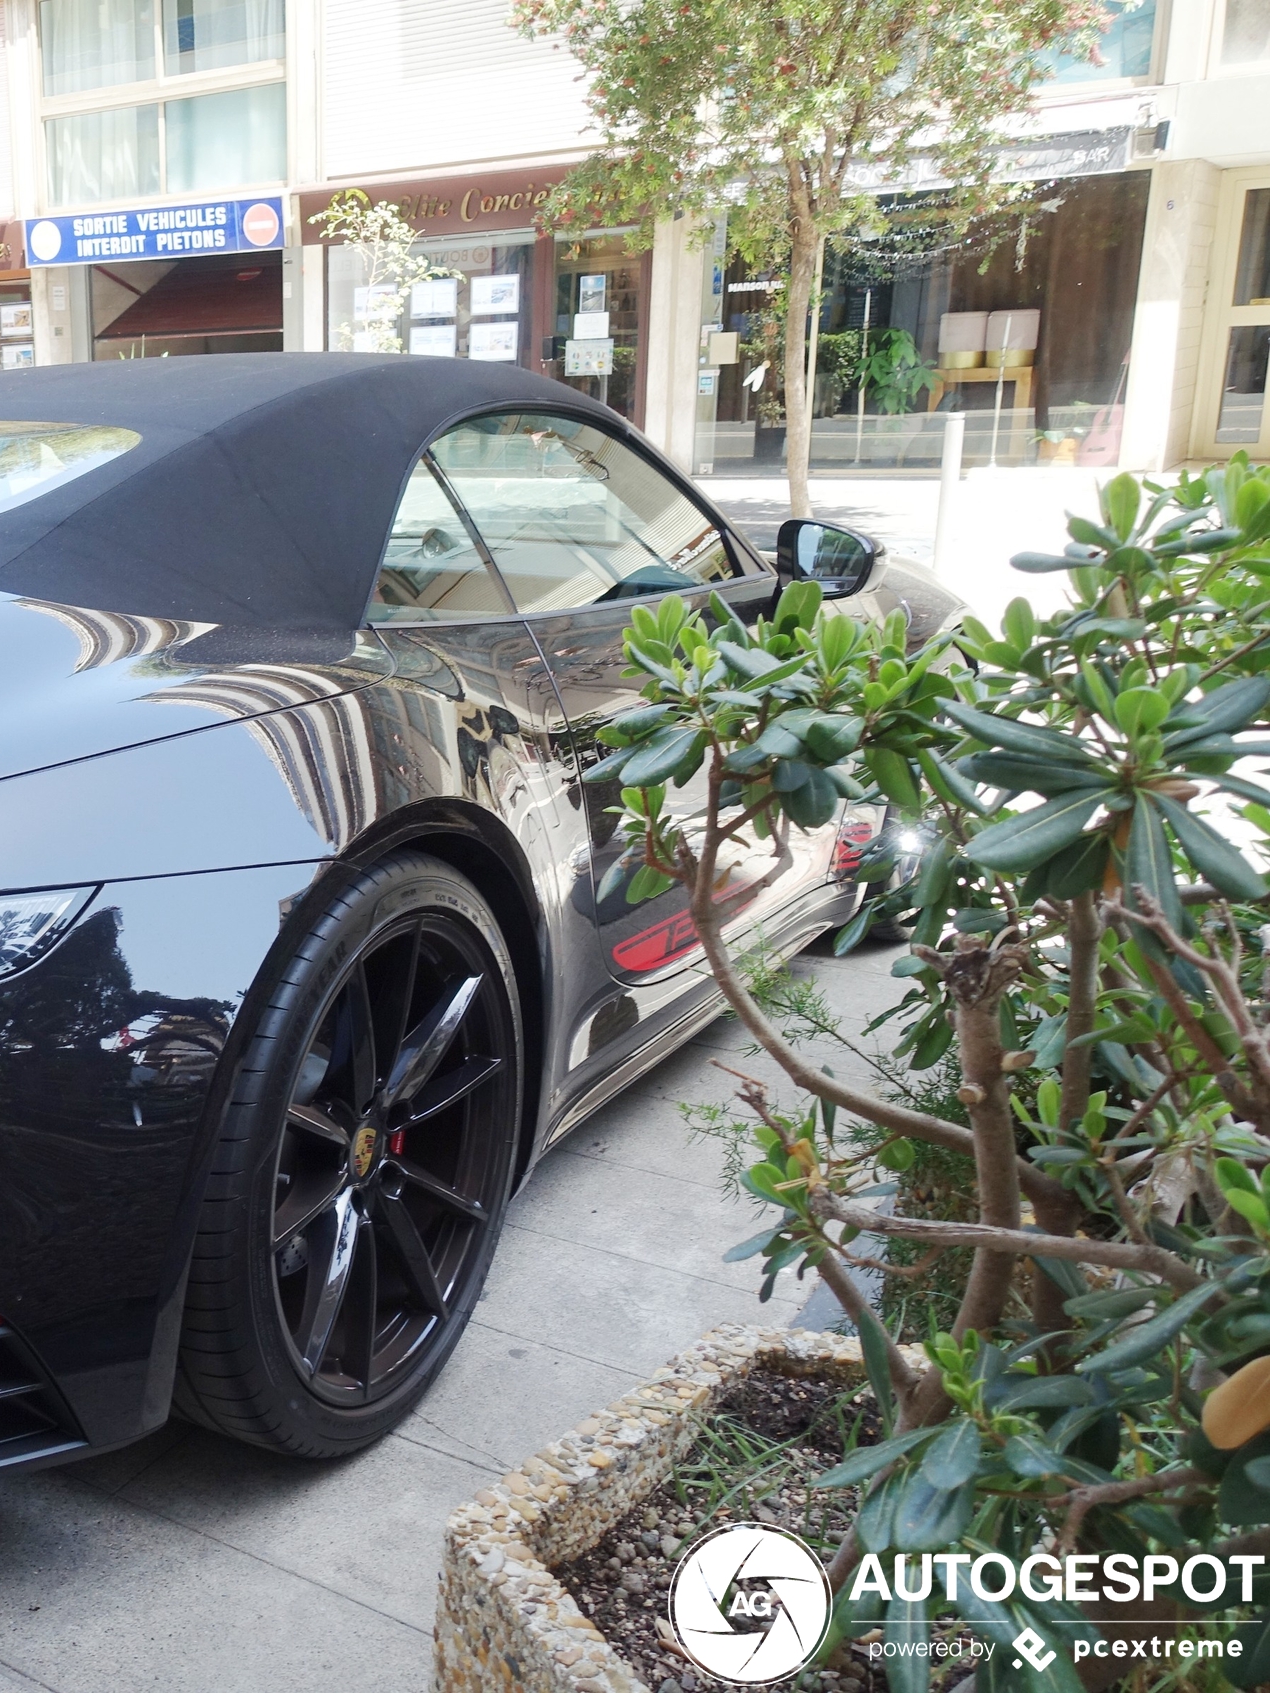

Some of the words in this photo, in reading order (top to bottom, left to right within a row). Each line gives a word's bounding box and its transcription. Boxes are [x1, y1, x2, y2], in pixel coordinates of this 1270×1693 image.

[398, 193, 452, 221] Elite
[460, 182, 561, 222] Concie
[1166, 199, 1175, 211] 6
[73, 215, 128, 236] SORTIE
[137, 207, 227, 232] VEHICULES
[77, 234, 146, 257] INTERDIT
[157, 230, 226, 252] PIETONS
